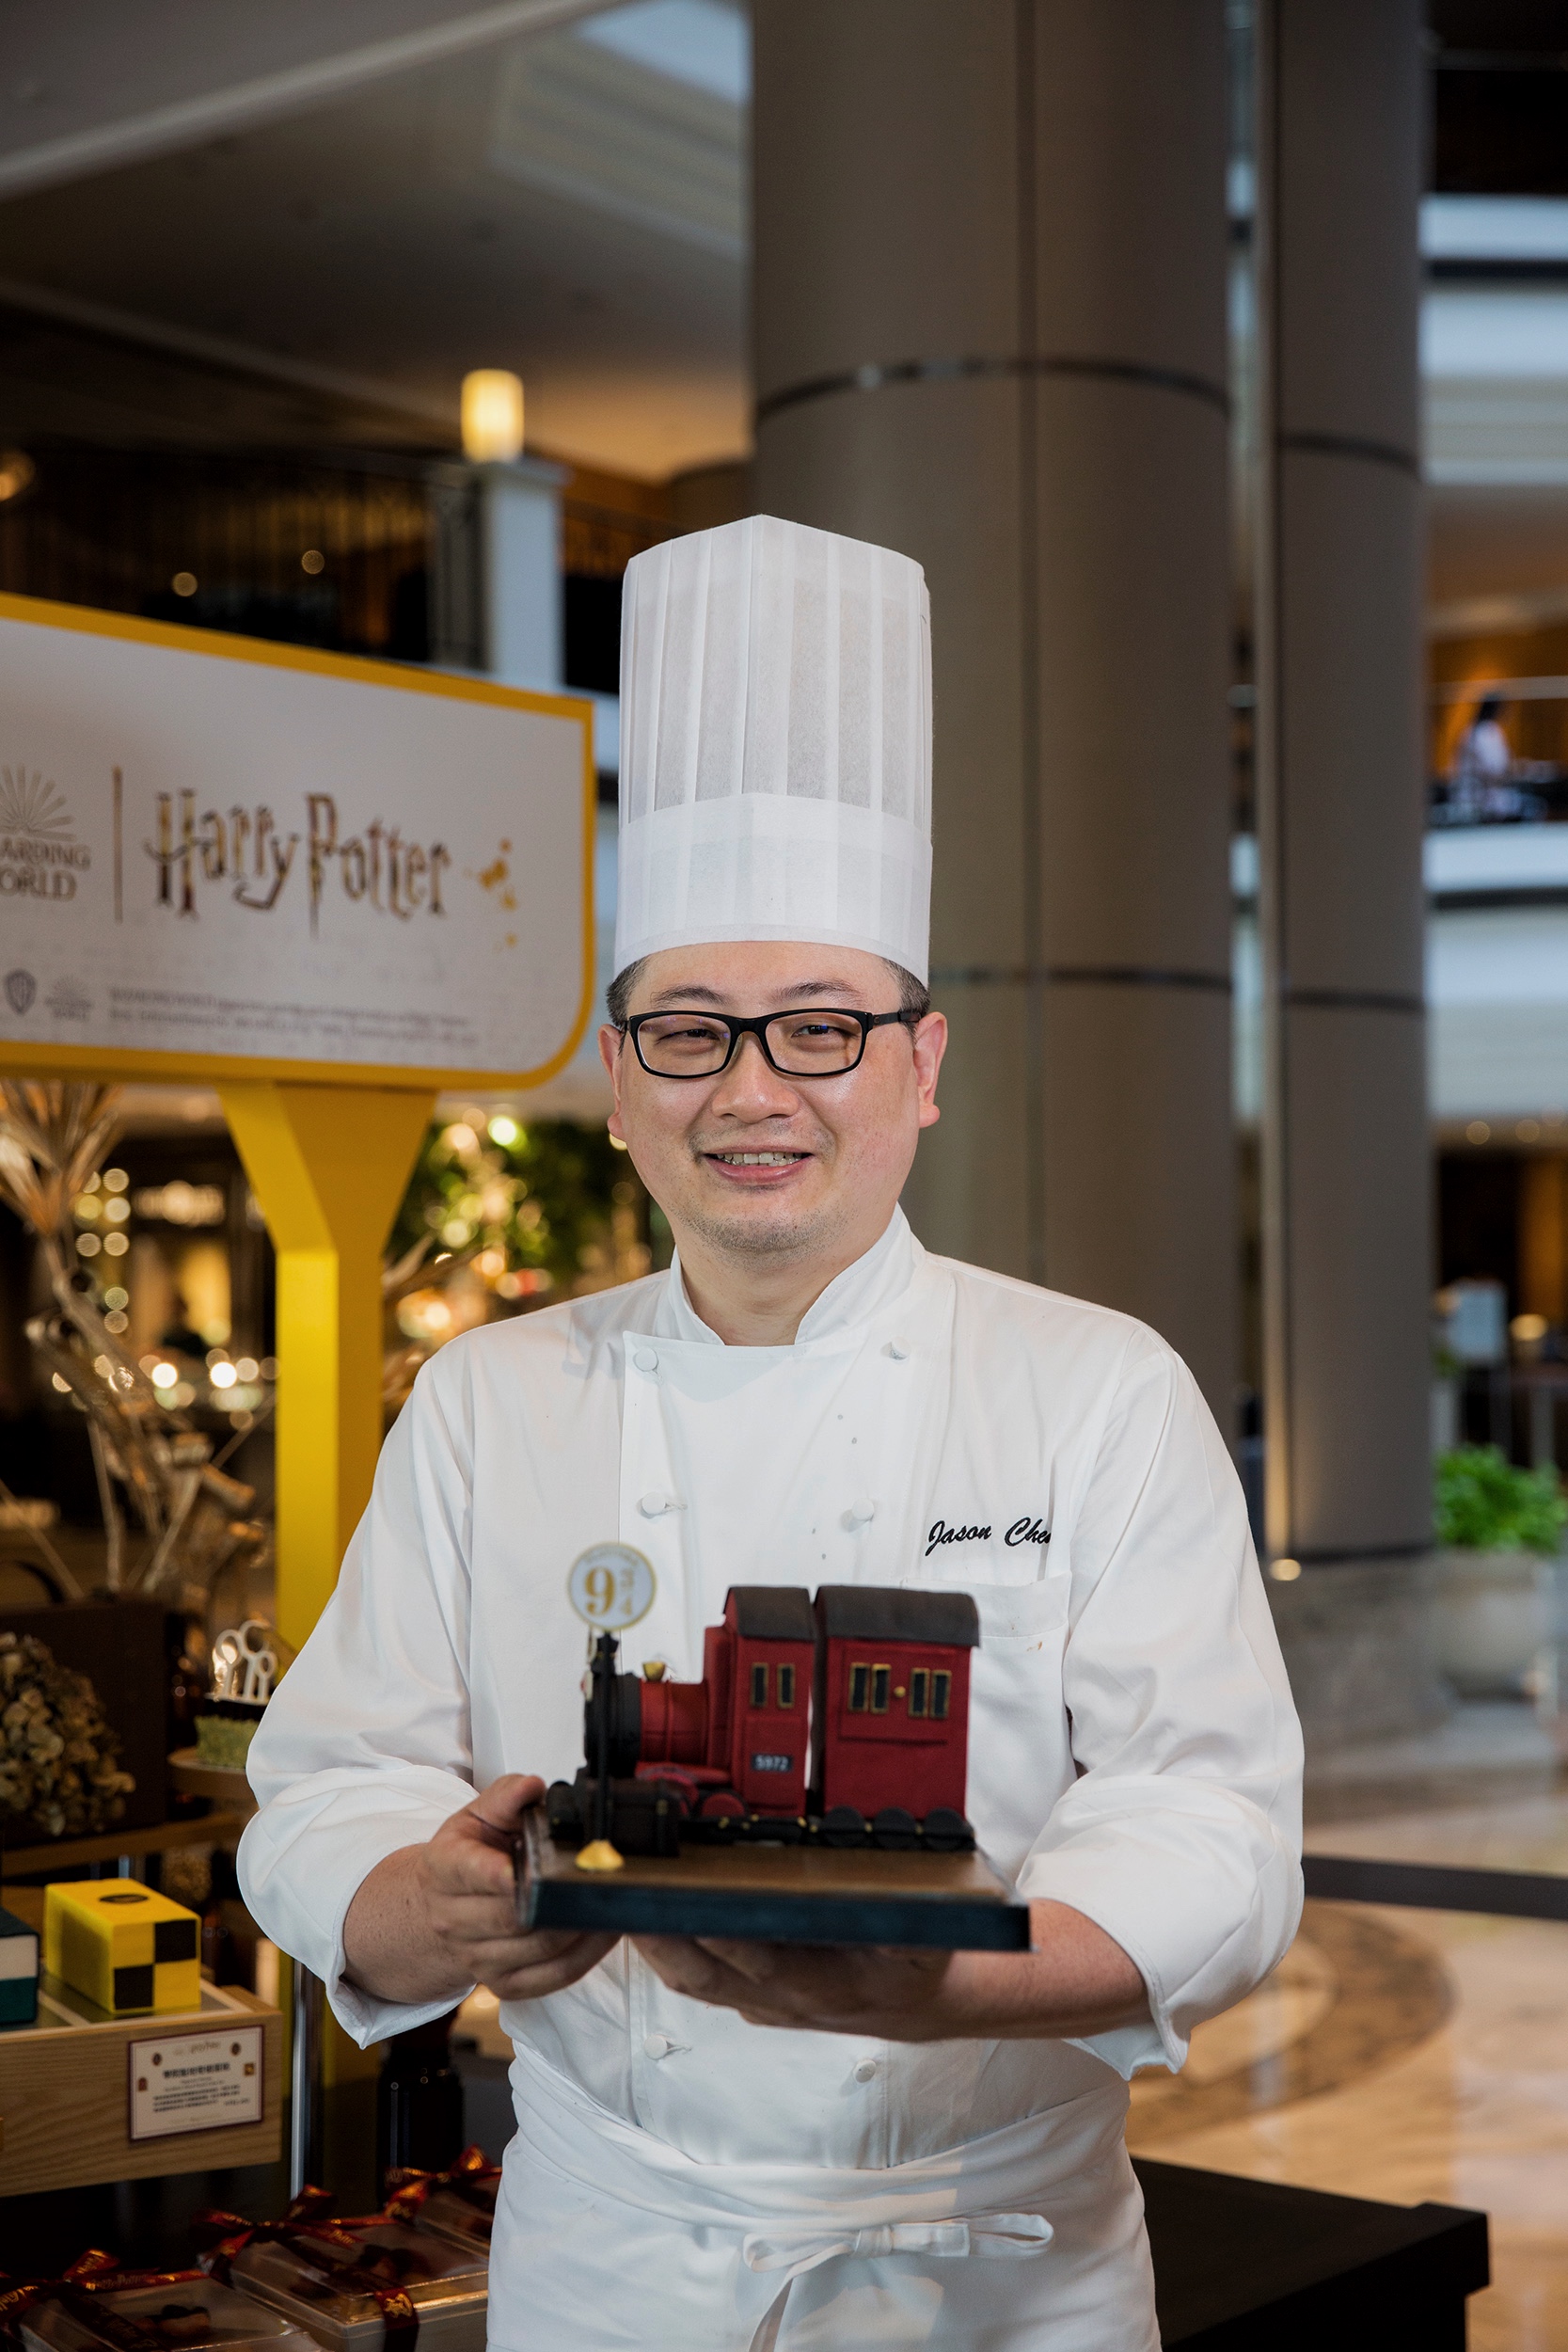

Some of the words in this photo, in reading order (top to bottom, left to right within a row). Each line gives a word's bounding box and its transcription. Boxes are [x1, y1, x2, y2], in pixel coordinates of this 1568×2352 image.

[144, 788, 301, 921] Harry
[306, 792, 451, 939] Potter
[925, 1520, 992, 1557] Jason
